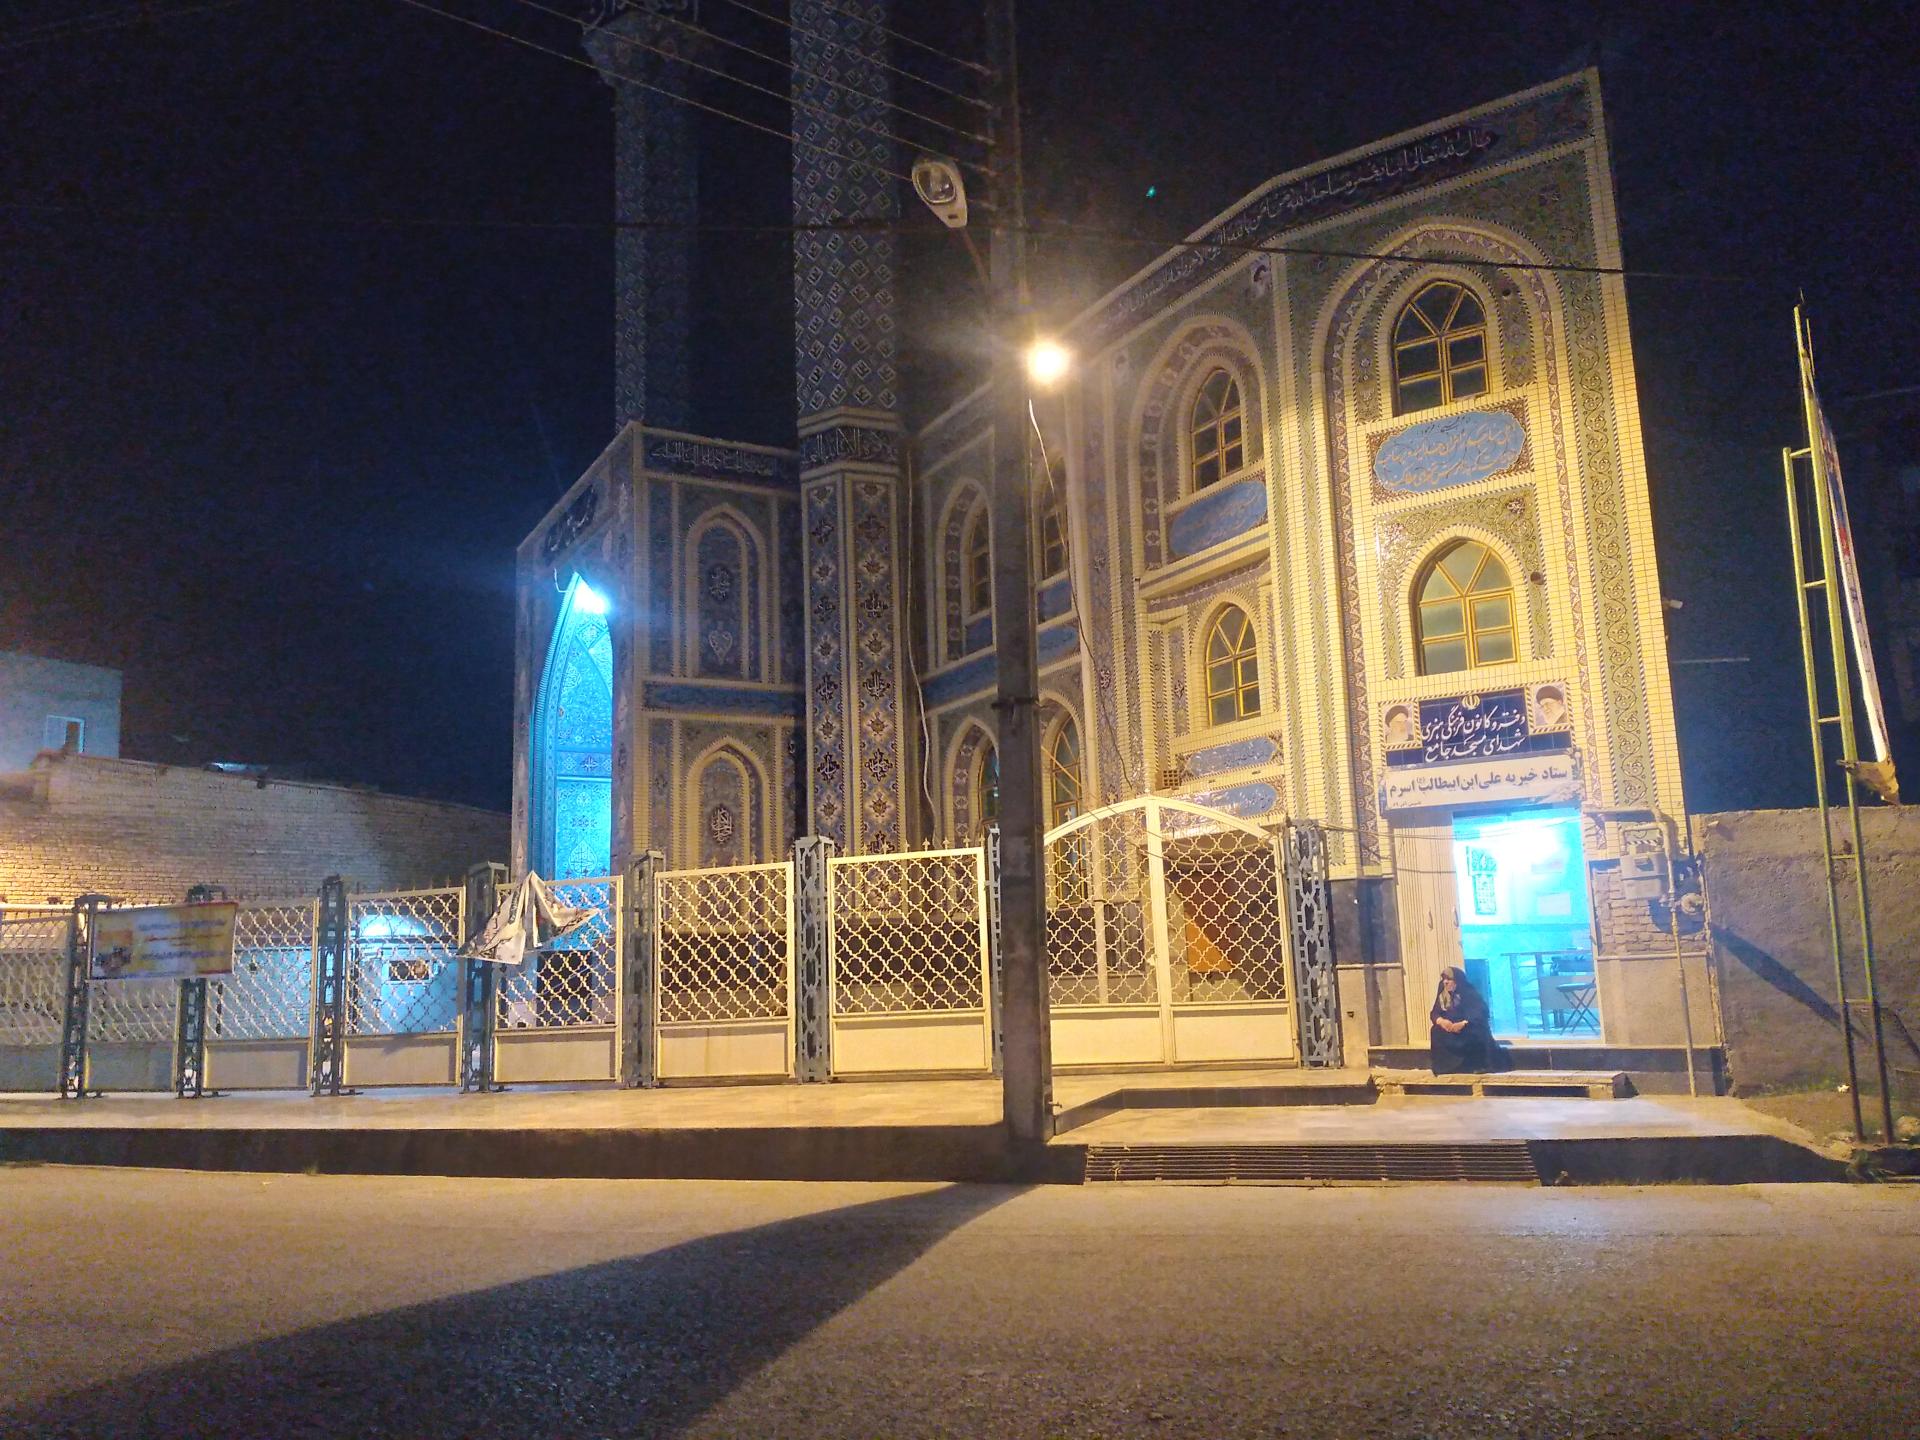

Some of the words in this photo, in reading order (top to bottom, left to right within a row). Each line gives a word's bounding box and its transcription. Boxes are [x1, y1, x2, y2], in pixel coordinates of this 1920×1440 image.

[1422, 718, 1444, 742] هنری
[1441, 704, 1465, 740] فرهنگی
[1463, 705, 1498, 734] کانون
[1497, 709, 1525, 731] دفتر
[1424, 741, 1452, 763] جامع
[1450, 733, 1487, 756] مسجد
[1483, 729, 1526, 755] شهدای
[1418, 775, 1460, 793] ابیطالب
[1460, 774, 1478, 791] ابن
[1479, 771, 1502, 789] علی
[1505, 767, 1537, 786] خیریه
[1542, 766, 1568, 780] ستاد
